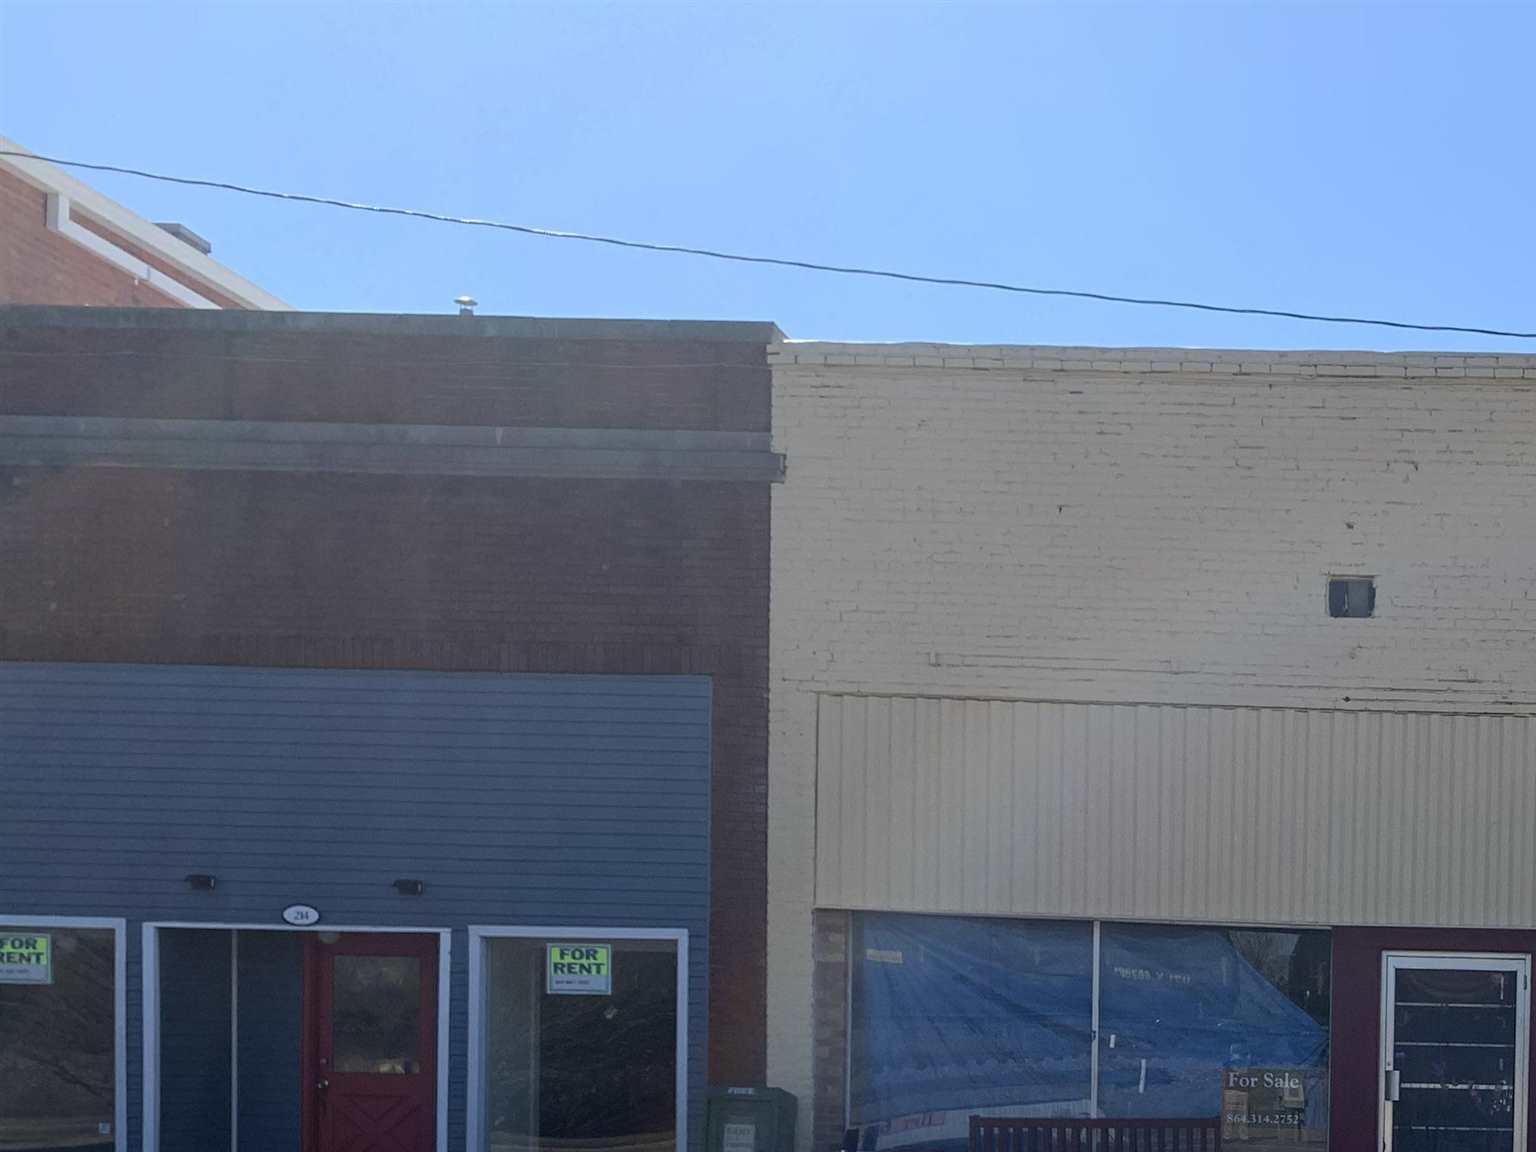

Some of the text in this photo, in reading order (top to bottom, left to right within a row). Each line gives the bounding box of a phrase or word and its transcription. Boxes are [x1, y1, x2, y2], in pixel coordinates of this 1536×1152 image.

[559, 948, 598, 961] FOR
[553, 962, 606, 975] RENT
[1228, 1071, 1300, 1089] For Sale
